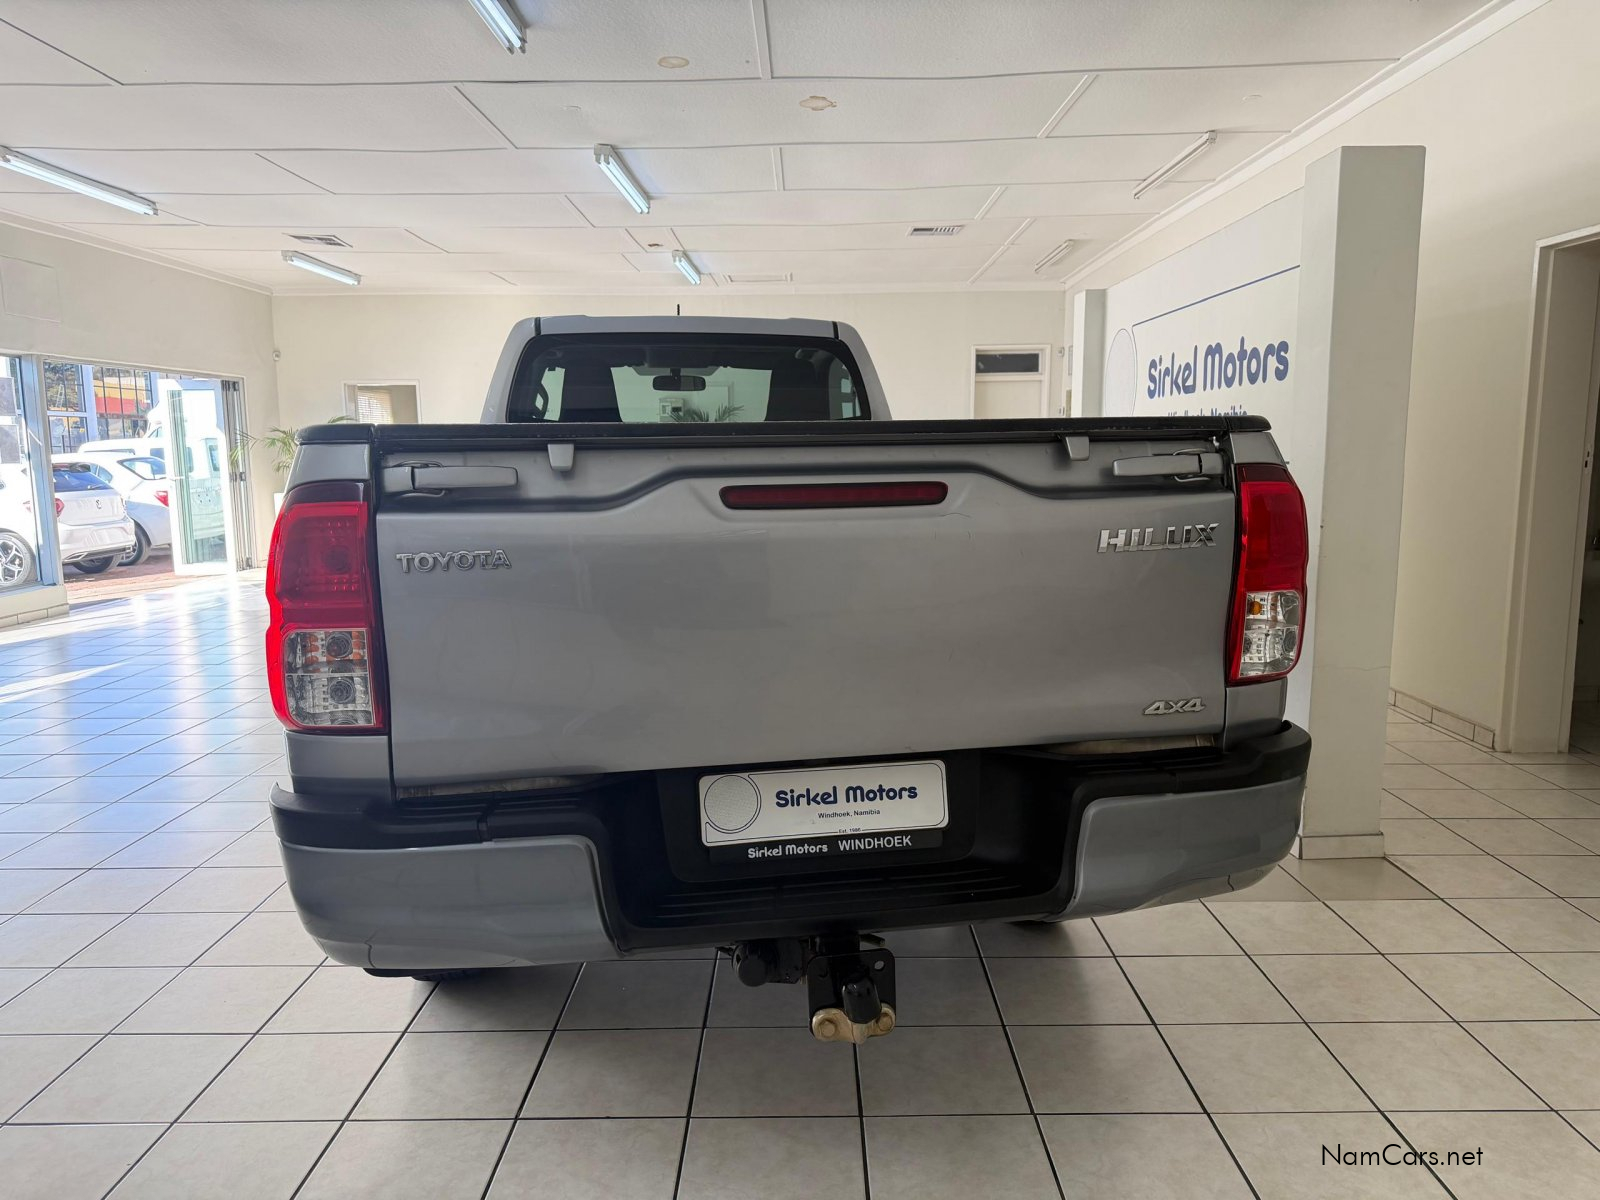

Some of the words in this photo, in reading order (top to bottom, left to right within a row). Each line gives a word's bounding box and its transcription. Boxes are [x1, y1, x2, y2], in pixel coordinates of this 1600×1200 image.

[1147, 345, 1197, 399] Sirkel
[1203, 336, 1289, 392] Motors
[1098, 523, 1219, 552] HILUX
[396, 550, 511, 573] TOYOTA
[775, 786, 837, 808] Sirkel
[845, 784, 918, 803] Motors
[817, 811, 853, 819] Windhoek,
[747, 845, 782, 859] Sirkel
[785, 843, 828, 855] Motors
[838, 835, 913, 851] WINDHOEK
